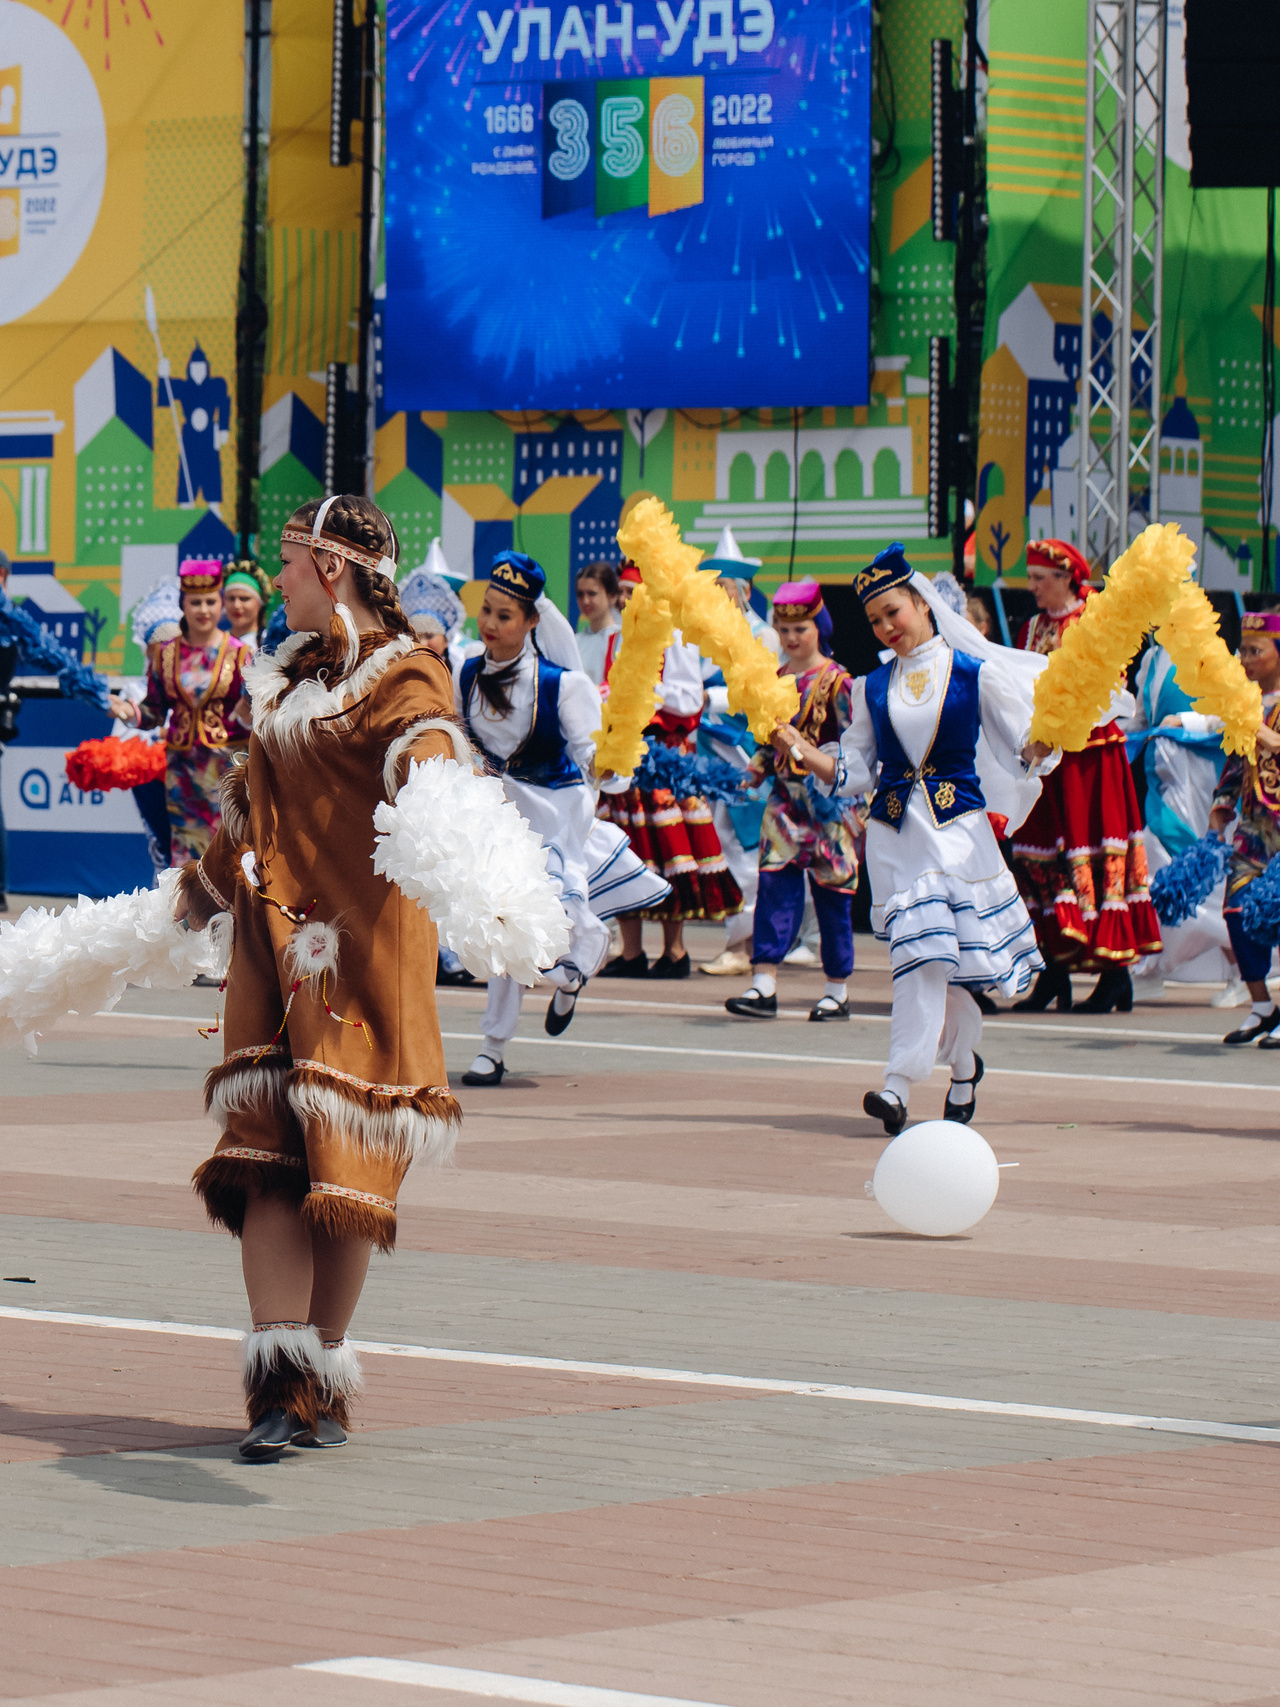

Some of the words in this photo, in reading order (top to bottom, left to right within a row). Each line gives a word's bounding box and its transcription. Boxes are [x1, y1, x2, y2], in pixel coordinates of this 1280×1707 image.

[477, 0, 775, 67] УЛАН-УДЭ
[483, 103, 535, 134] 1666
[711, 93, 773, 126] 2022
